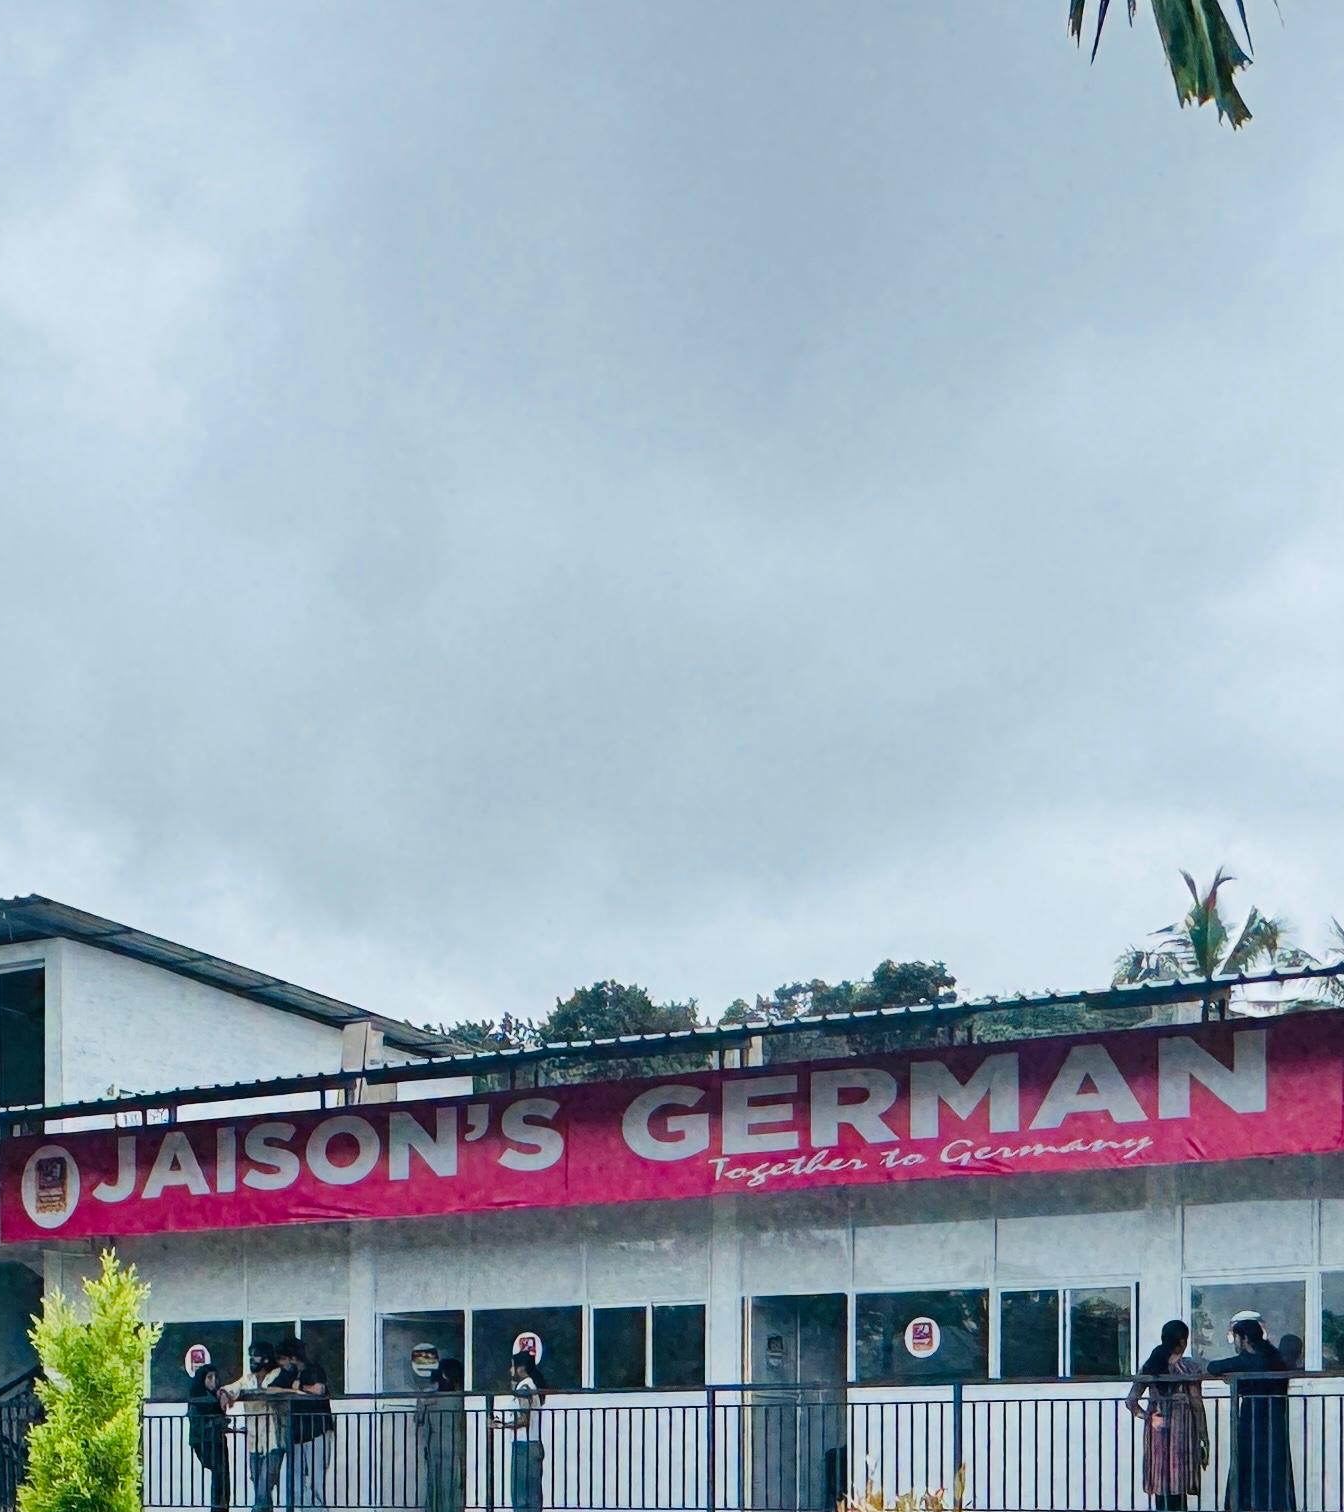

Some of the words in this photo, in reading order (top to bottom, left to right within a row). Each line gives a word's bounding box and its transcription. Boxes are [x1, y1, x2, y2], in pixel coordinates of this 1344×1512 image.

[93, 1099, 564, 1202] JAISON'S
[622, 1030, 1267, 1161] GERMAN
[708, 1150, 867, 1187] Together
[880, 1148, 926, 1167] to
[939, 1136, 1153, 1165] Germany
